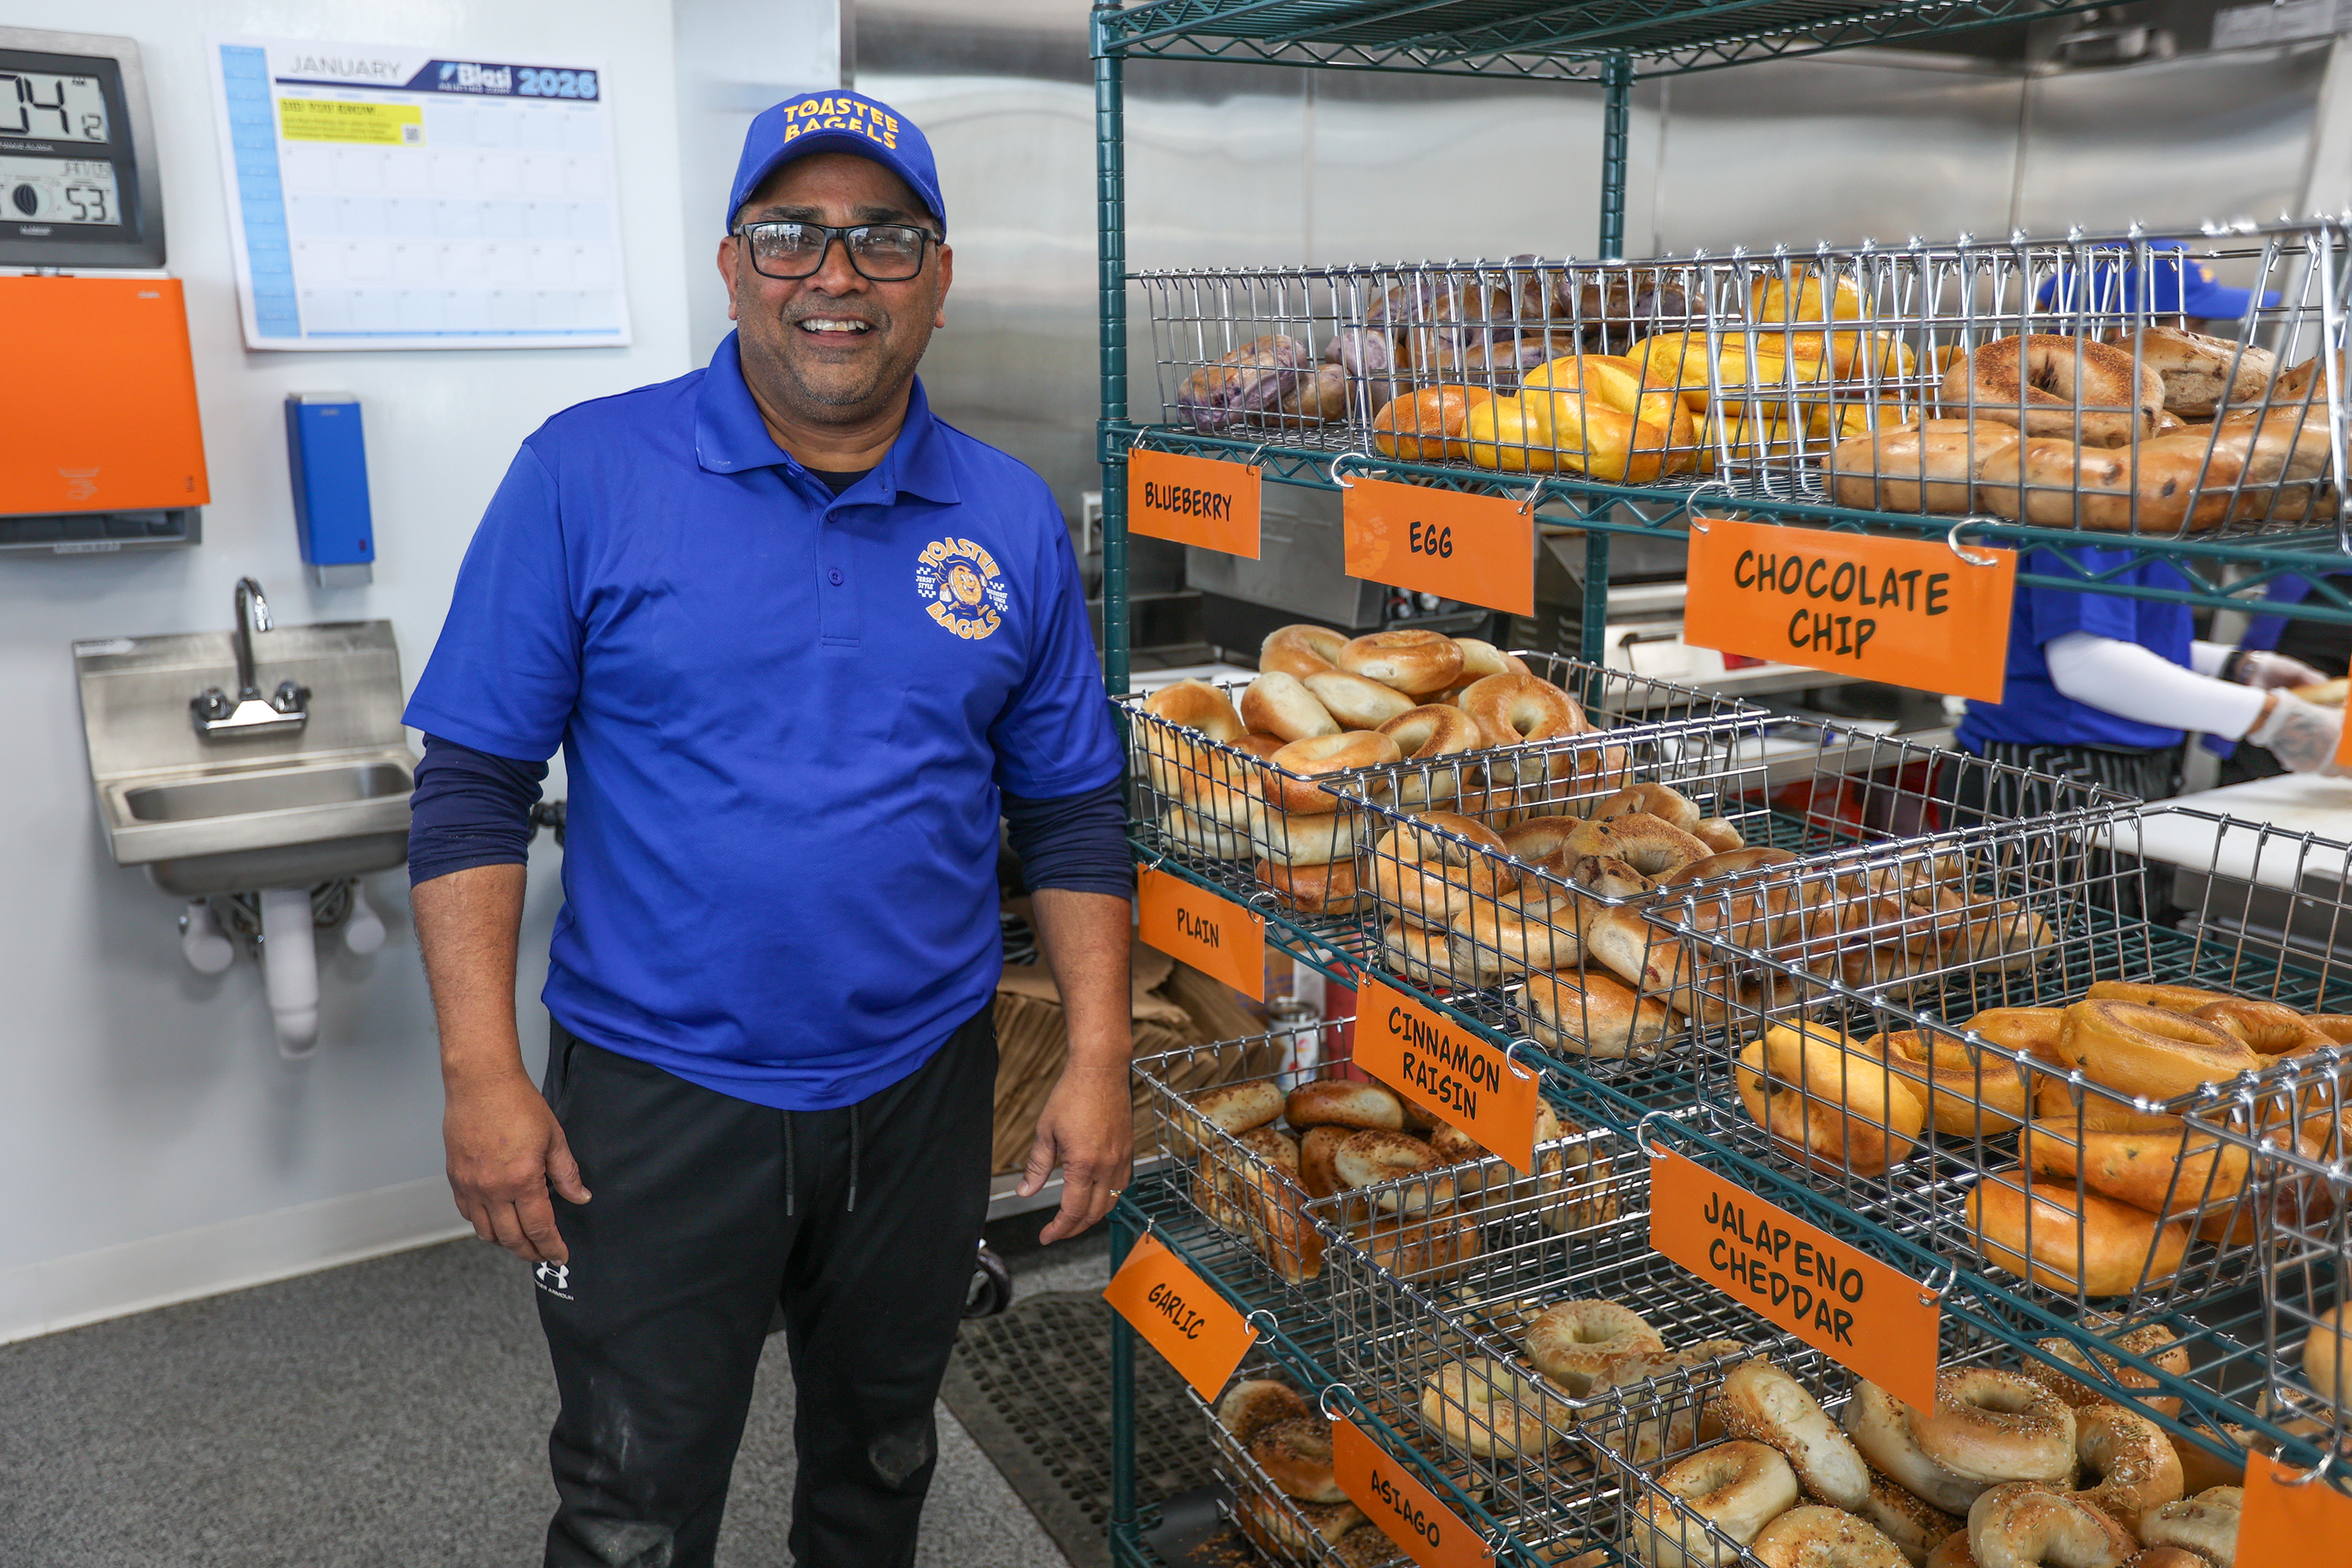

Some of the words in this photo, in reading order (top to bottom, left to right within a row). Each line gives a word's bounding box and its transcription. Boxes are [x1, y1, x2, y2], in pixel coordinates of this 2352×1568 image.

[289, 56, 402, 78] JANUARY
[517, 67, 598, 100] 2026
[784, 97, 900, 133] TOASTEE
[784, 115, 898, 150] BAGELS
[65, 187, 107, 223] 53
[1145, 481, 1232, 523] BLUEBERRY
[917, 537, 1001, 580] TOASTEE
[1410, 521, 1454, 559] EGG
[1734, 549, 1951, 617] CHOCOLATE
[925, 601, 1001, 640] BAGELS
[1788, 608, 1876, 660] CHIP
[1177, 907, 1219, 948] PLAIN
[1388, 1006, 1501, 1094] CINNAMON
[1403, 1051, 1477, 1120] RAISIN
[1704, 1191, 1864, 1304] JALAPENO
[1148, 1283, 1204, 1341] GARLIC
[1708, 1238, 1854, 1348] CHEDDAR
[1370, 1469, 1441, 1548] ASIAGO
